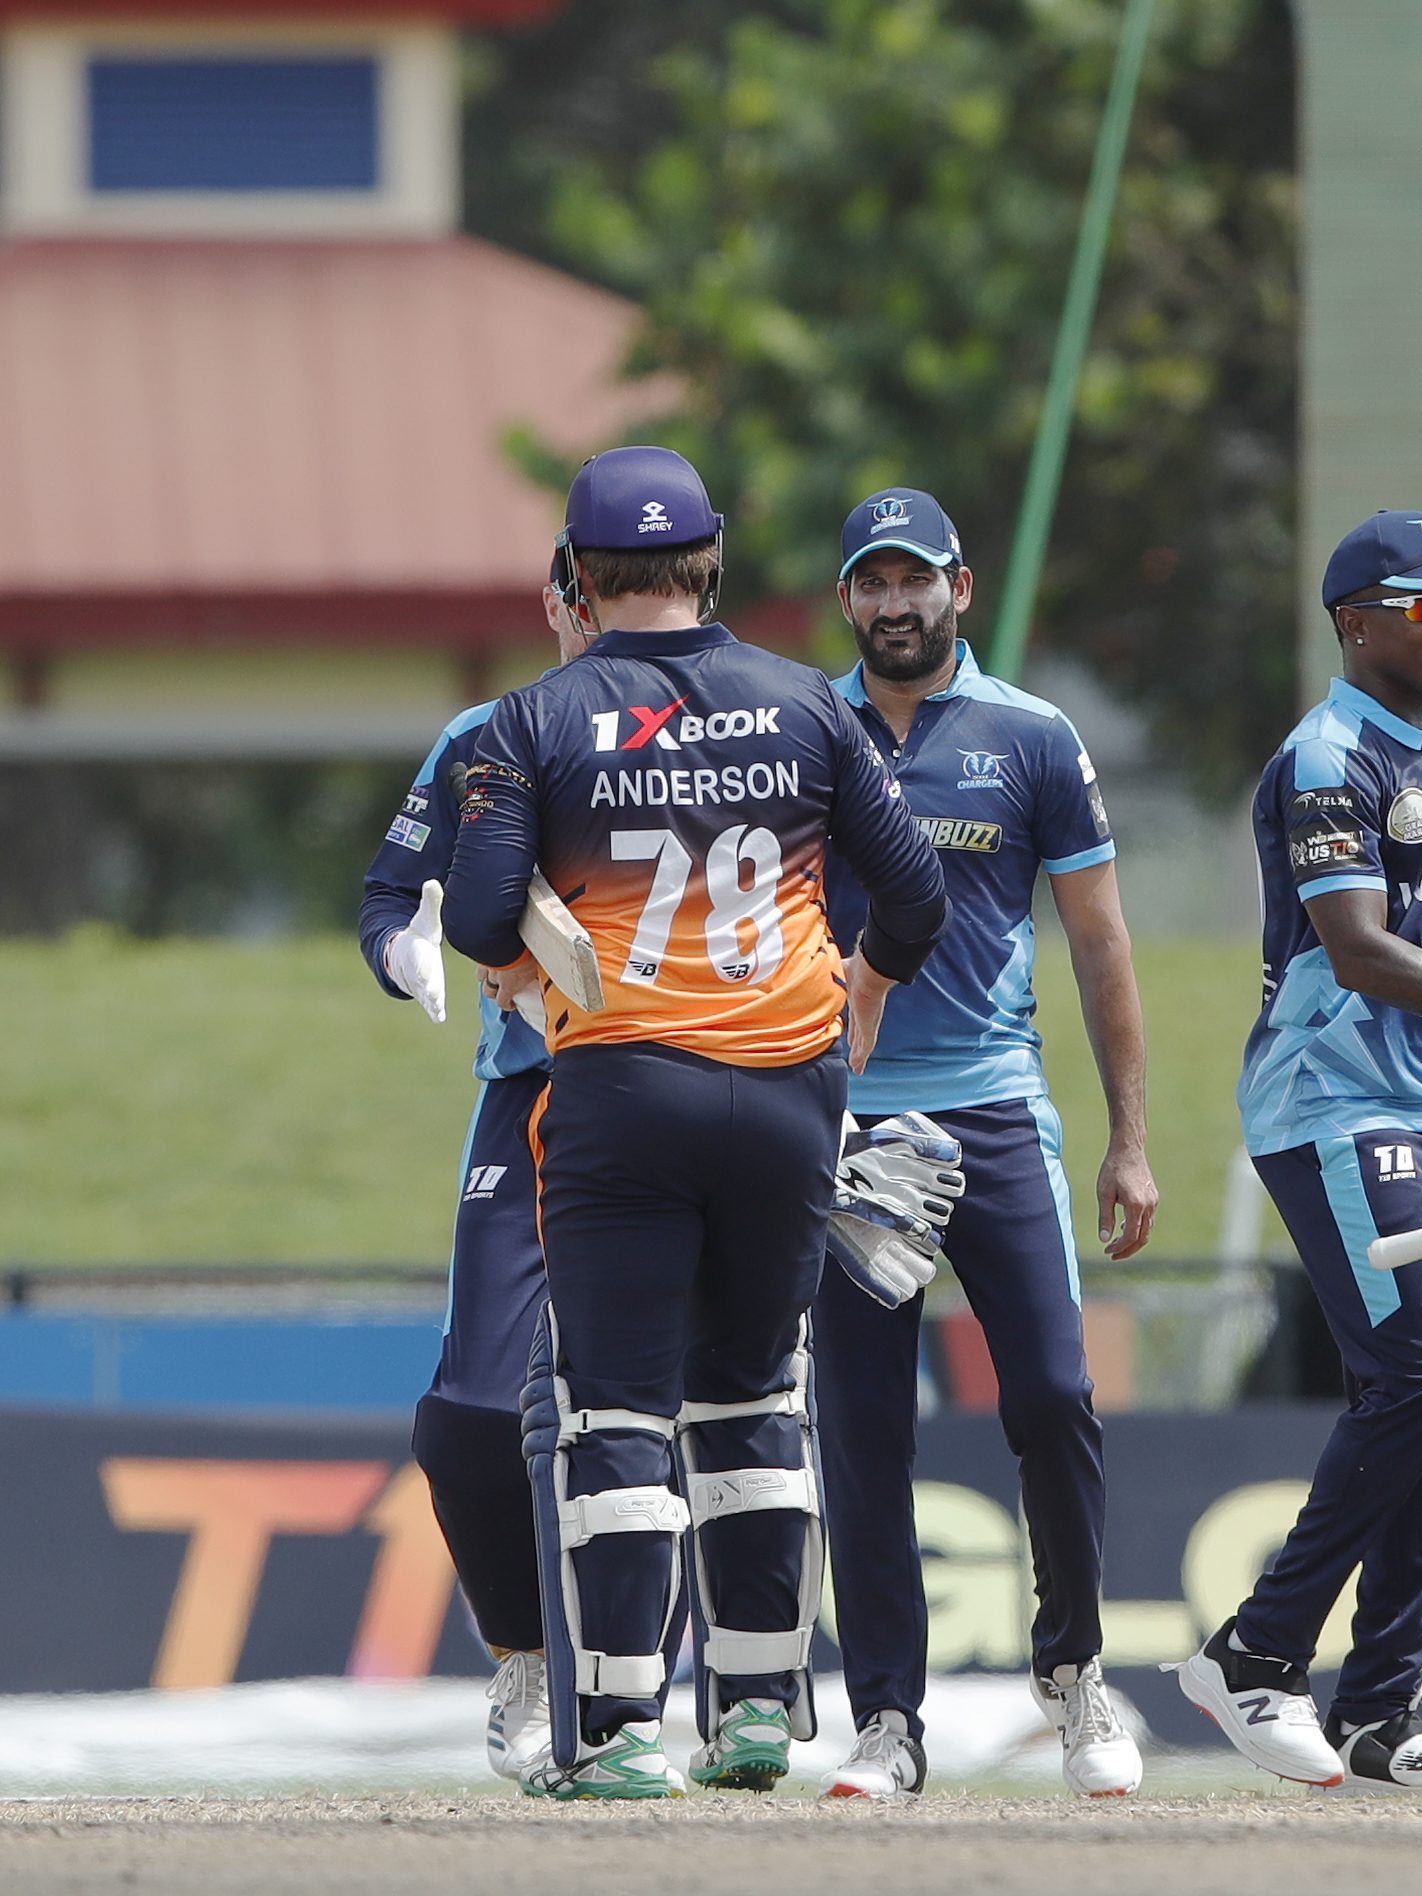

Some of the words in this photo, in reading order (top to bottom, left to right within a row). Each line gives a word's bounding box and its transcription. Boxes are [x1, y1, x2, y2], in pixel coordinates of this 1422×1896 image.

[590, 759, 799, 809] ANDERSON
[610, 823, 785, 986] 78
[101, 1458, 462, 1690] T1
